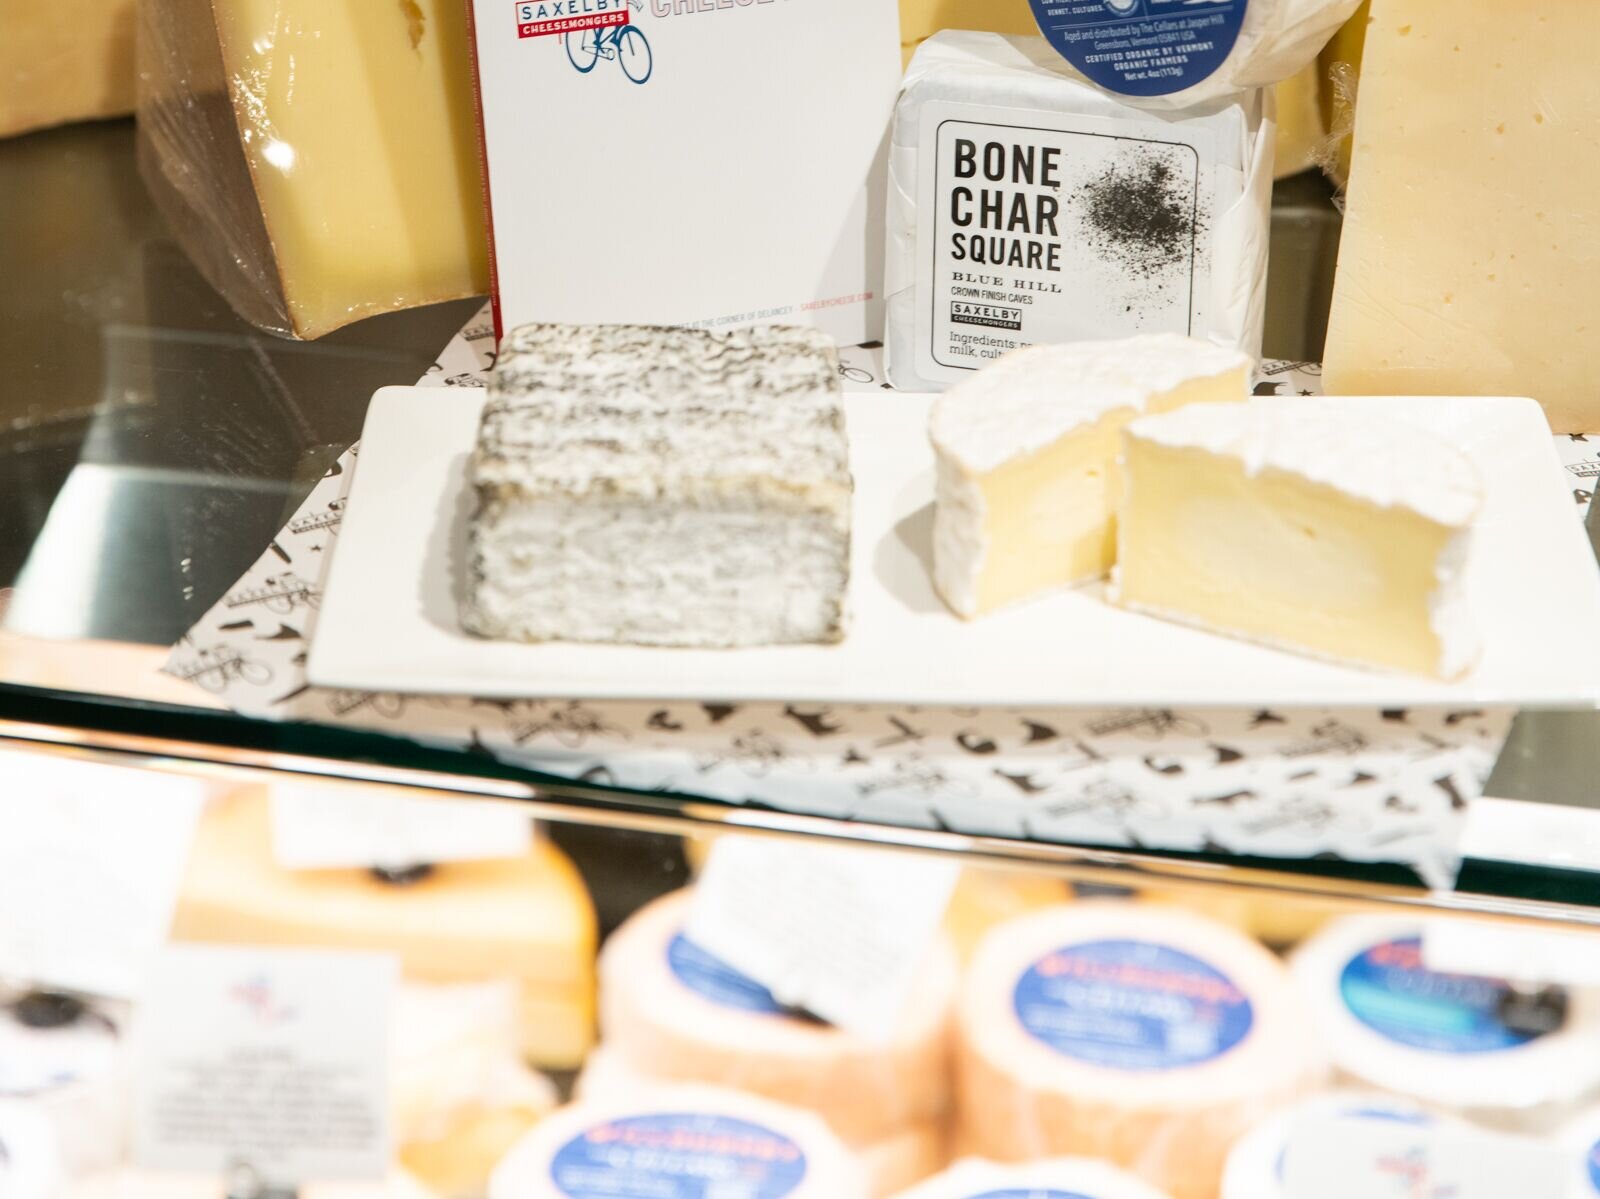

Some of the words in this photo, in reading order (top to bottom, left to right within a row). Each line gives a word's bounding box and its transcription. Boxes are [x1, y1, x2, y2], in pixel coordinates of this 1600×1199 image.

[522, 12, 626, 35] CHEESEMONGERS
[954, 138, 1062, 188] BONE
[950, 186, 1060, 237] CHAR
[951, 232, 1062, 272] SQUARE
[952, 271, 1004, 286] BLUE
[1014, 279, 1062, 293] HILL
[951, 286, 980, 298] CROWN
[981, 289, 1007, 301] FINISH
[1008, 293, 1033, 305] CAVES
[953, 315, 1018, 329] CHEESEMONGERS
[954, 304, 1019, 320] SAXELBY
[950, 331, 1017, 349] Ingredients:
[949, 345, 978, 358] milk,
